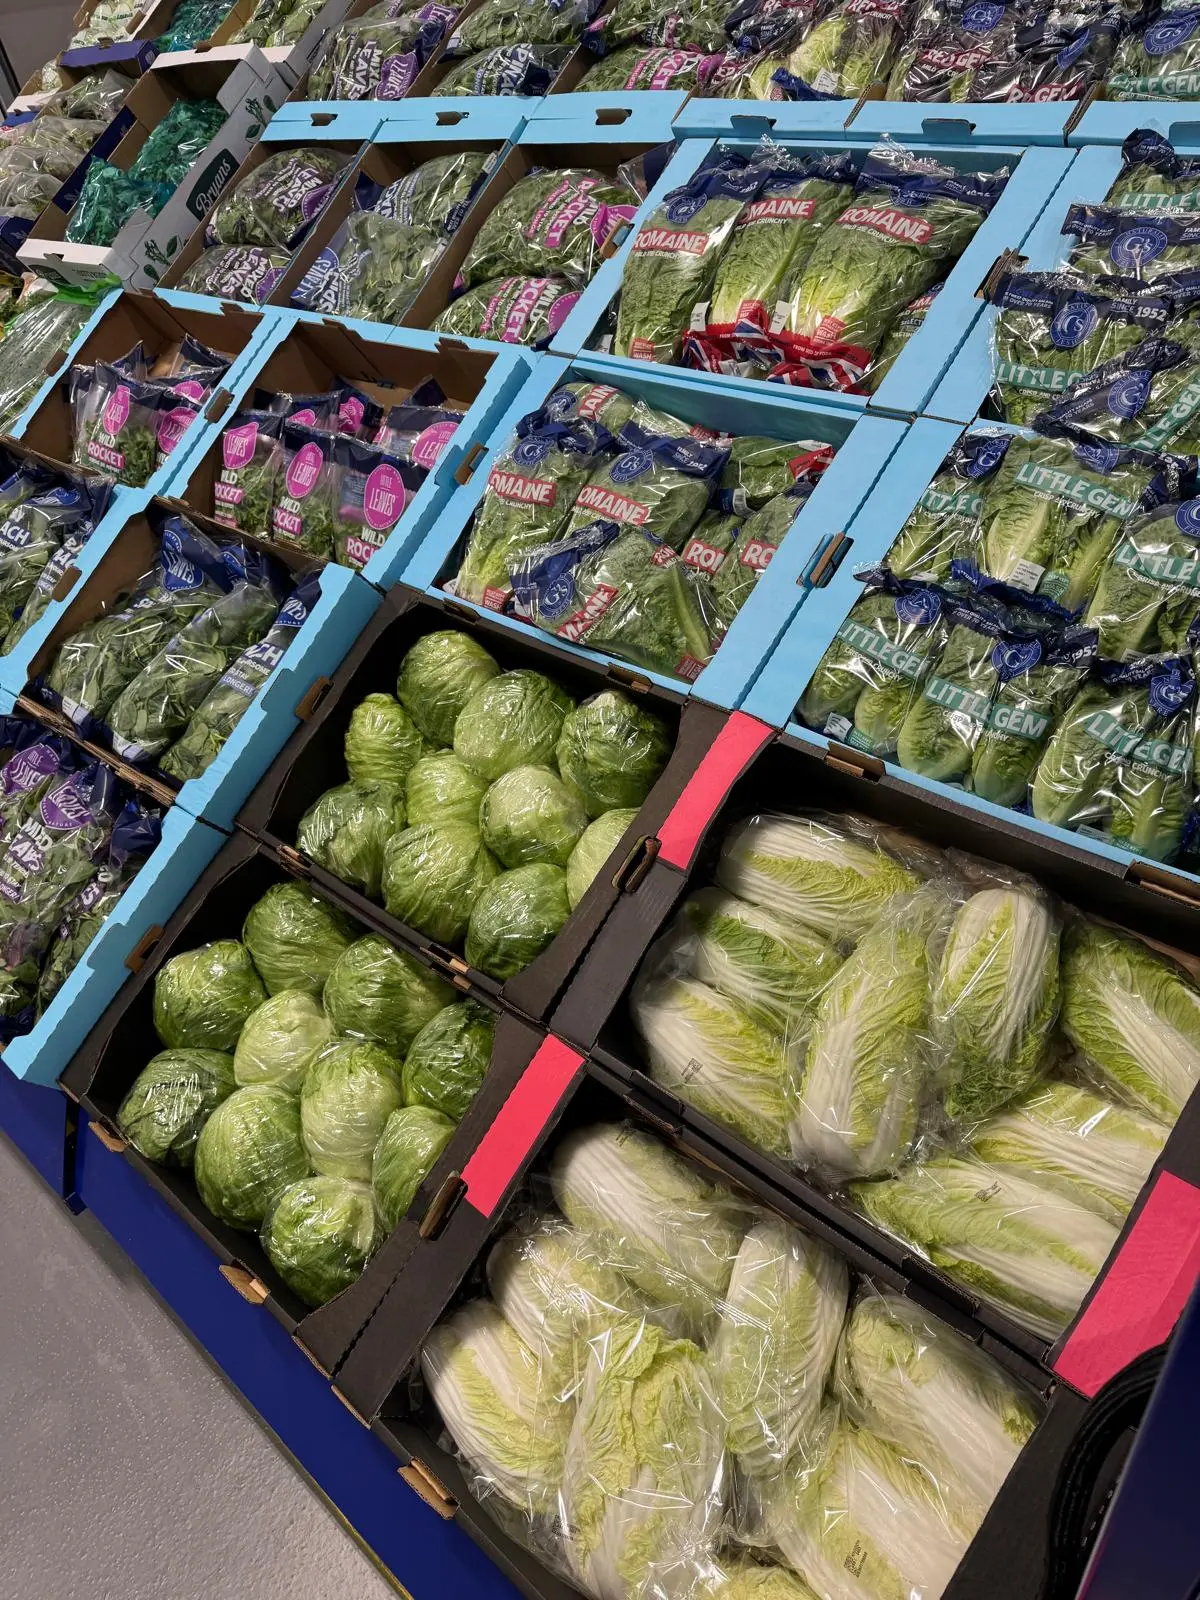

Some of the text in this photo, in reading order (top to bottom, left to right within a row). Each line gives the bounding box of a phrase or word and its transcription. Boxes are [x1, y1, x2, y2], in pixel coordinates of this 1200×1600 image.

[196, 158, 231, 215] Bryans
[272, 167, 320, 212] LEAVES
[288, 176, 323, 208] MIXED
[1120, 192, 1191, 209] LITTLE
[839, 208, 931, 243] ROMAINE
[221, 247, 264, 294] LEAVES
[240, 257, 268, 298] MIXED
[507, 278, 547, 338] OCKET
[530, 283, 563, 323] WILD
[1110, 302, 1135, 313] SINCE
[1112, 296, 1138, 305] FAMILY
[1135, 306, 1168, 322] 1952
[997, 362, 1066, 390] LITTLE
[87, 441, 124, 468] ROCKET
[98, 432, 116, 449] WILD
[227, 434, 249, 457] LEAVES
[523, 443, 545, 457] G's
[620, 454, 641, 471] G's
[490, 473, 554, 503] OMAINE
[1016, 463, 1090, 498] LITTLE
[280, 496, 300, 514] WILD
[368, 487, 397, 517] LEAVES
[578, 487, 647, 526] OMAINE
[1033, 490, 1055, 501] CRISP
[1067, 500, 1101, 518] CRUNCHY
[361, 527, 386, 547] WILD
[162, 550, 196, 584] LEAVES
[1116, 543, 1195, 581] LITTLE
[484, 600, 501, 610] WASH
[544, 583, 569, 606] G's
[873, 662, 903, 682] CRUNCHY
[994, 707, 1049, 738] GEM
